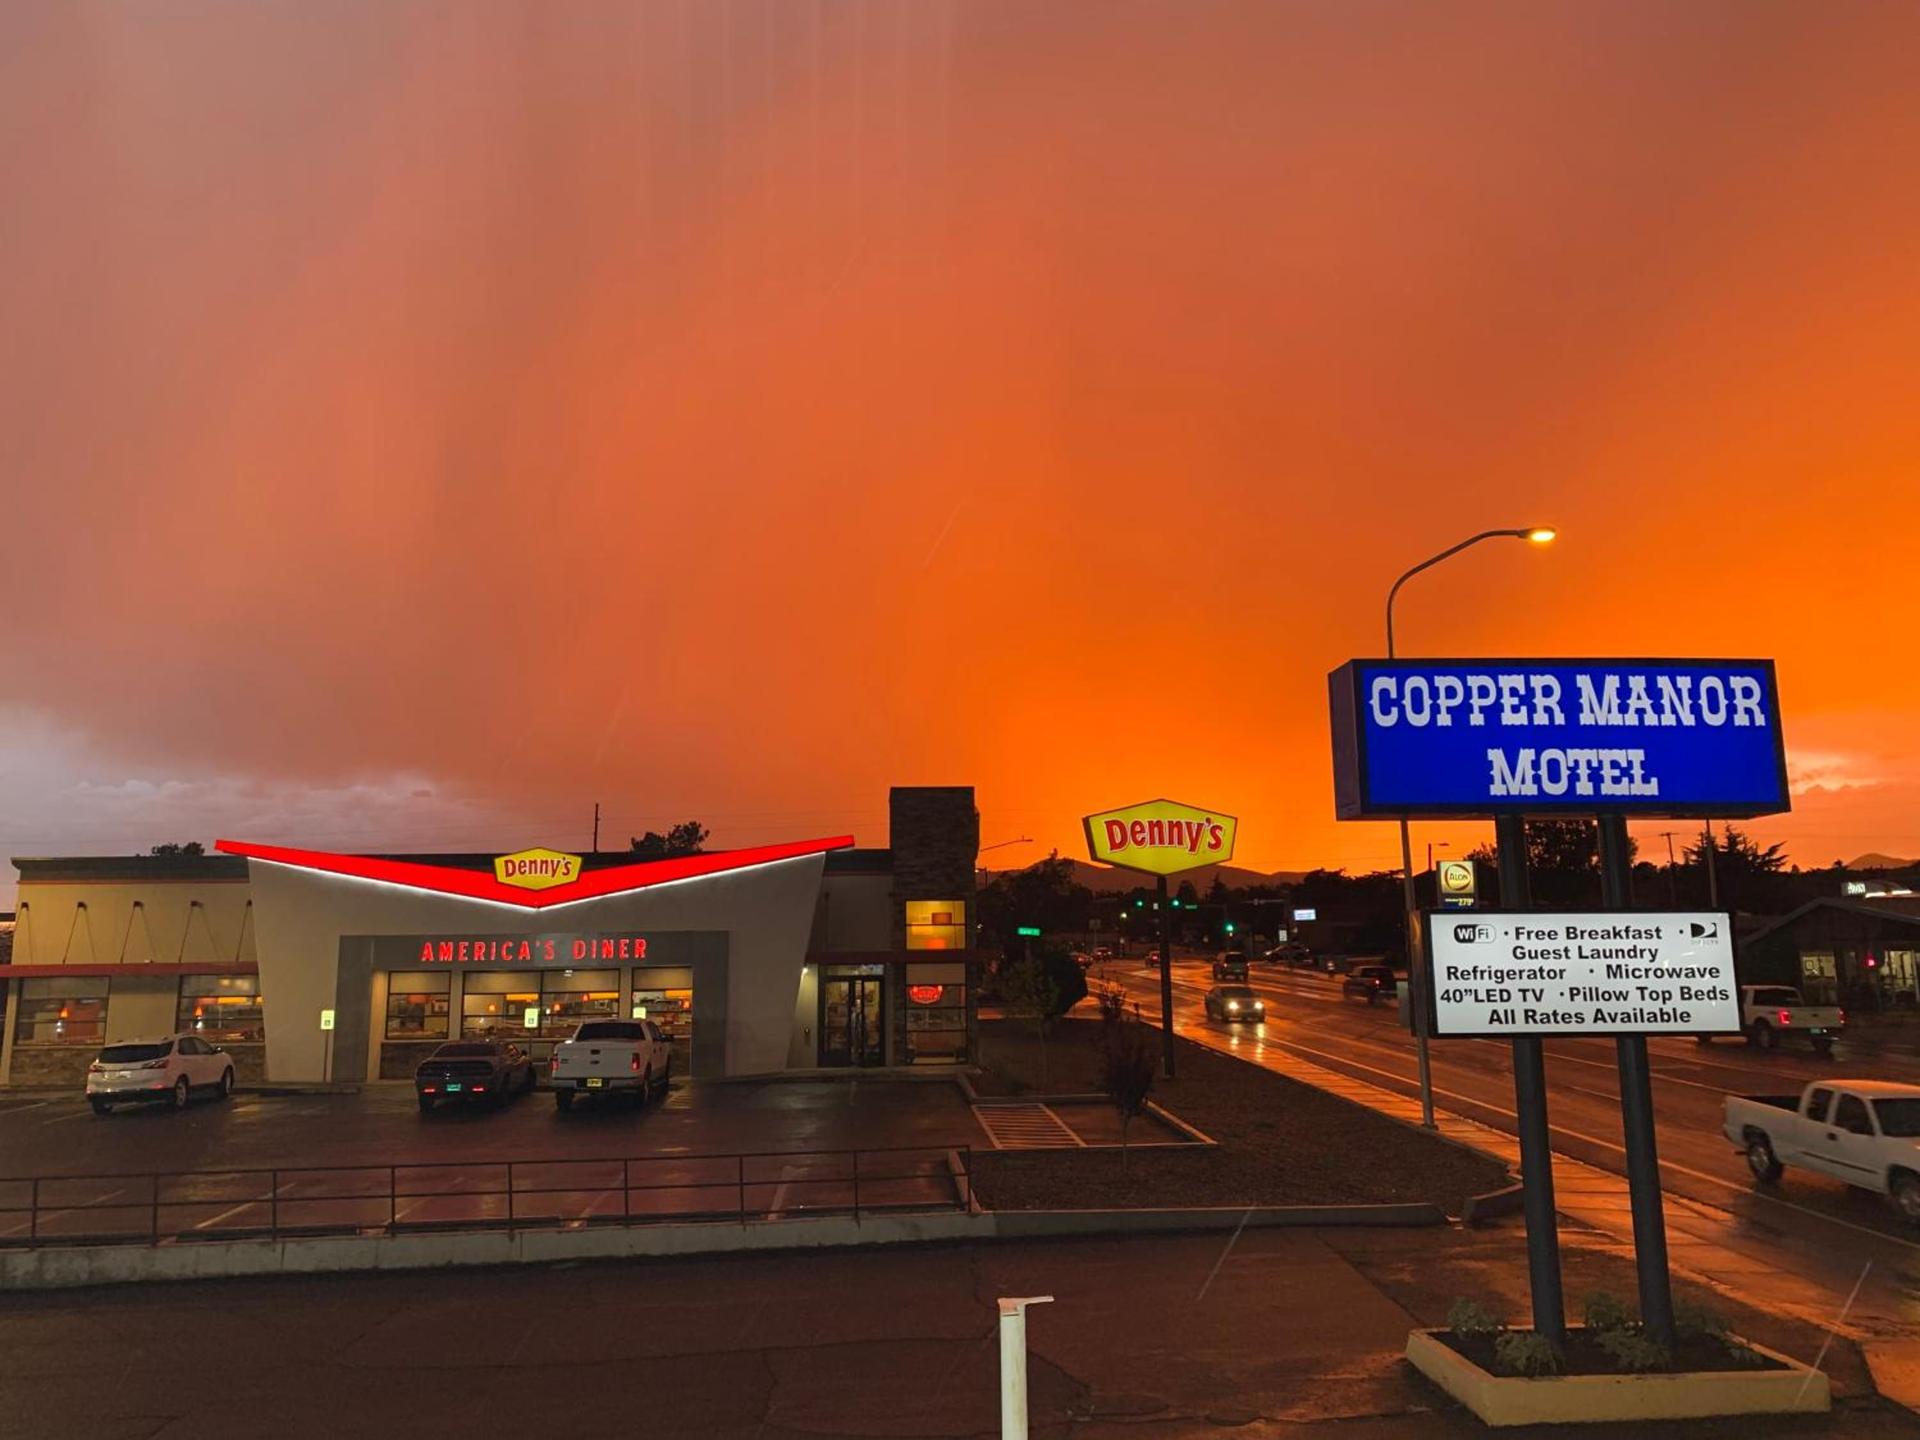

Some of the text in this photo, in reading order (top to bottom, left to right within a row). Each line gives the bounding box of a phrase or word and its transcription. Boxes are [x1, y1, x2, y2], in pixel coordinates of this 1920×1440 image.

[1369, 674, 1766, 727] COPPER MANOR
[1487, 748, 1659, 796] MOTEL
[1104, 816, 1225, 855] Denny's
[502, 856, 573, 879] Denny's
[1514, 926, 1559, 941] Free
[1565, 925, 1662, 940] Breakfast
[421, 938, 648, 962] AMERICA'S DINER
[1512, 944, 1659, 963] Guest Laundry
[1446, 963, 1721, 984] Refrigerator Microwave
[1517, 988, 1545, 1003] TV
[1568, 986, 1630, 1002] Pillow
[1635, 986, 1673, 1005] Top
[1679, 985, 1730, 1001] Beds
[1488, 1007, 1692, 1025] All Rates Available
